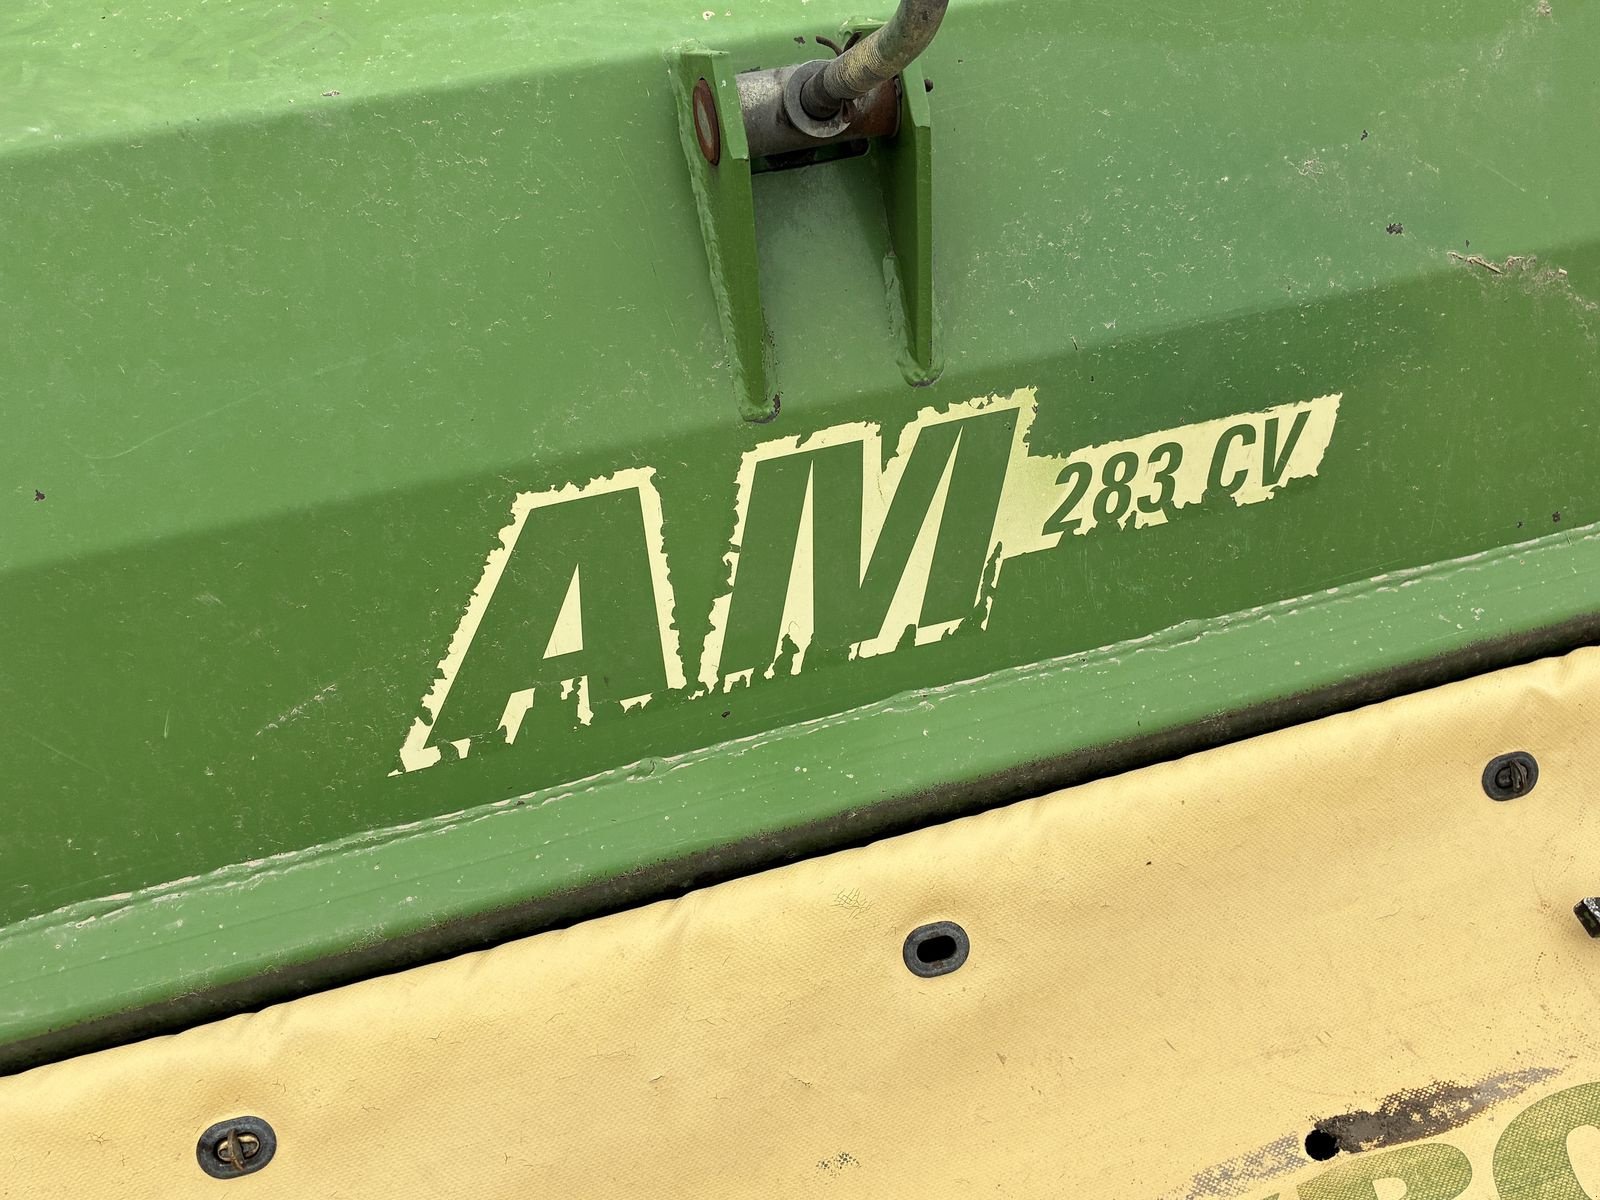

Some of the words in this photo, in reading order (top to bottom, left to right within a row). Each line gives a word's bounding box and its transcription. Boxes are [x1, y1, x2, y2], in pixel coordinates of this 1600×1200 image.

[414, 402, 1022, 756] AM
[1041, 441, 1184, 537] 283
[1206, 410, 1313, 497] CV
